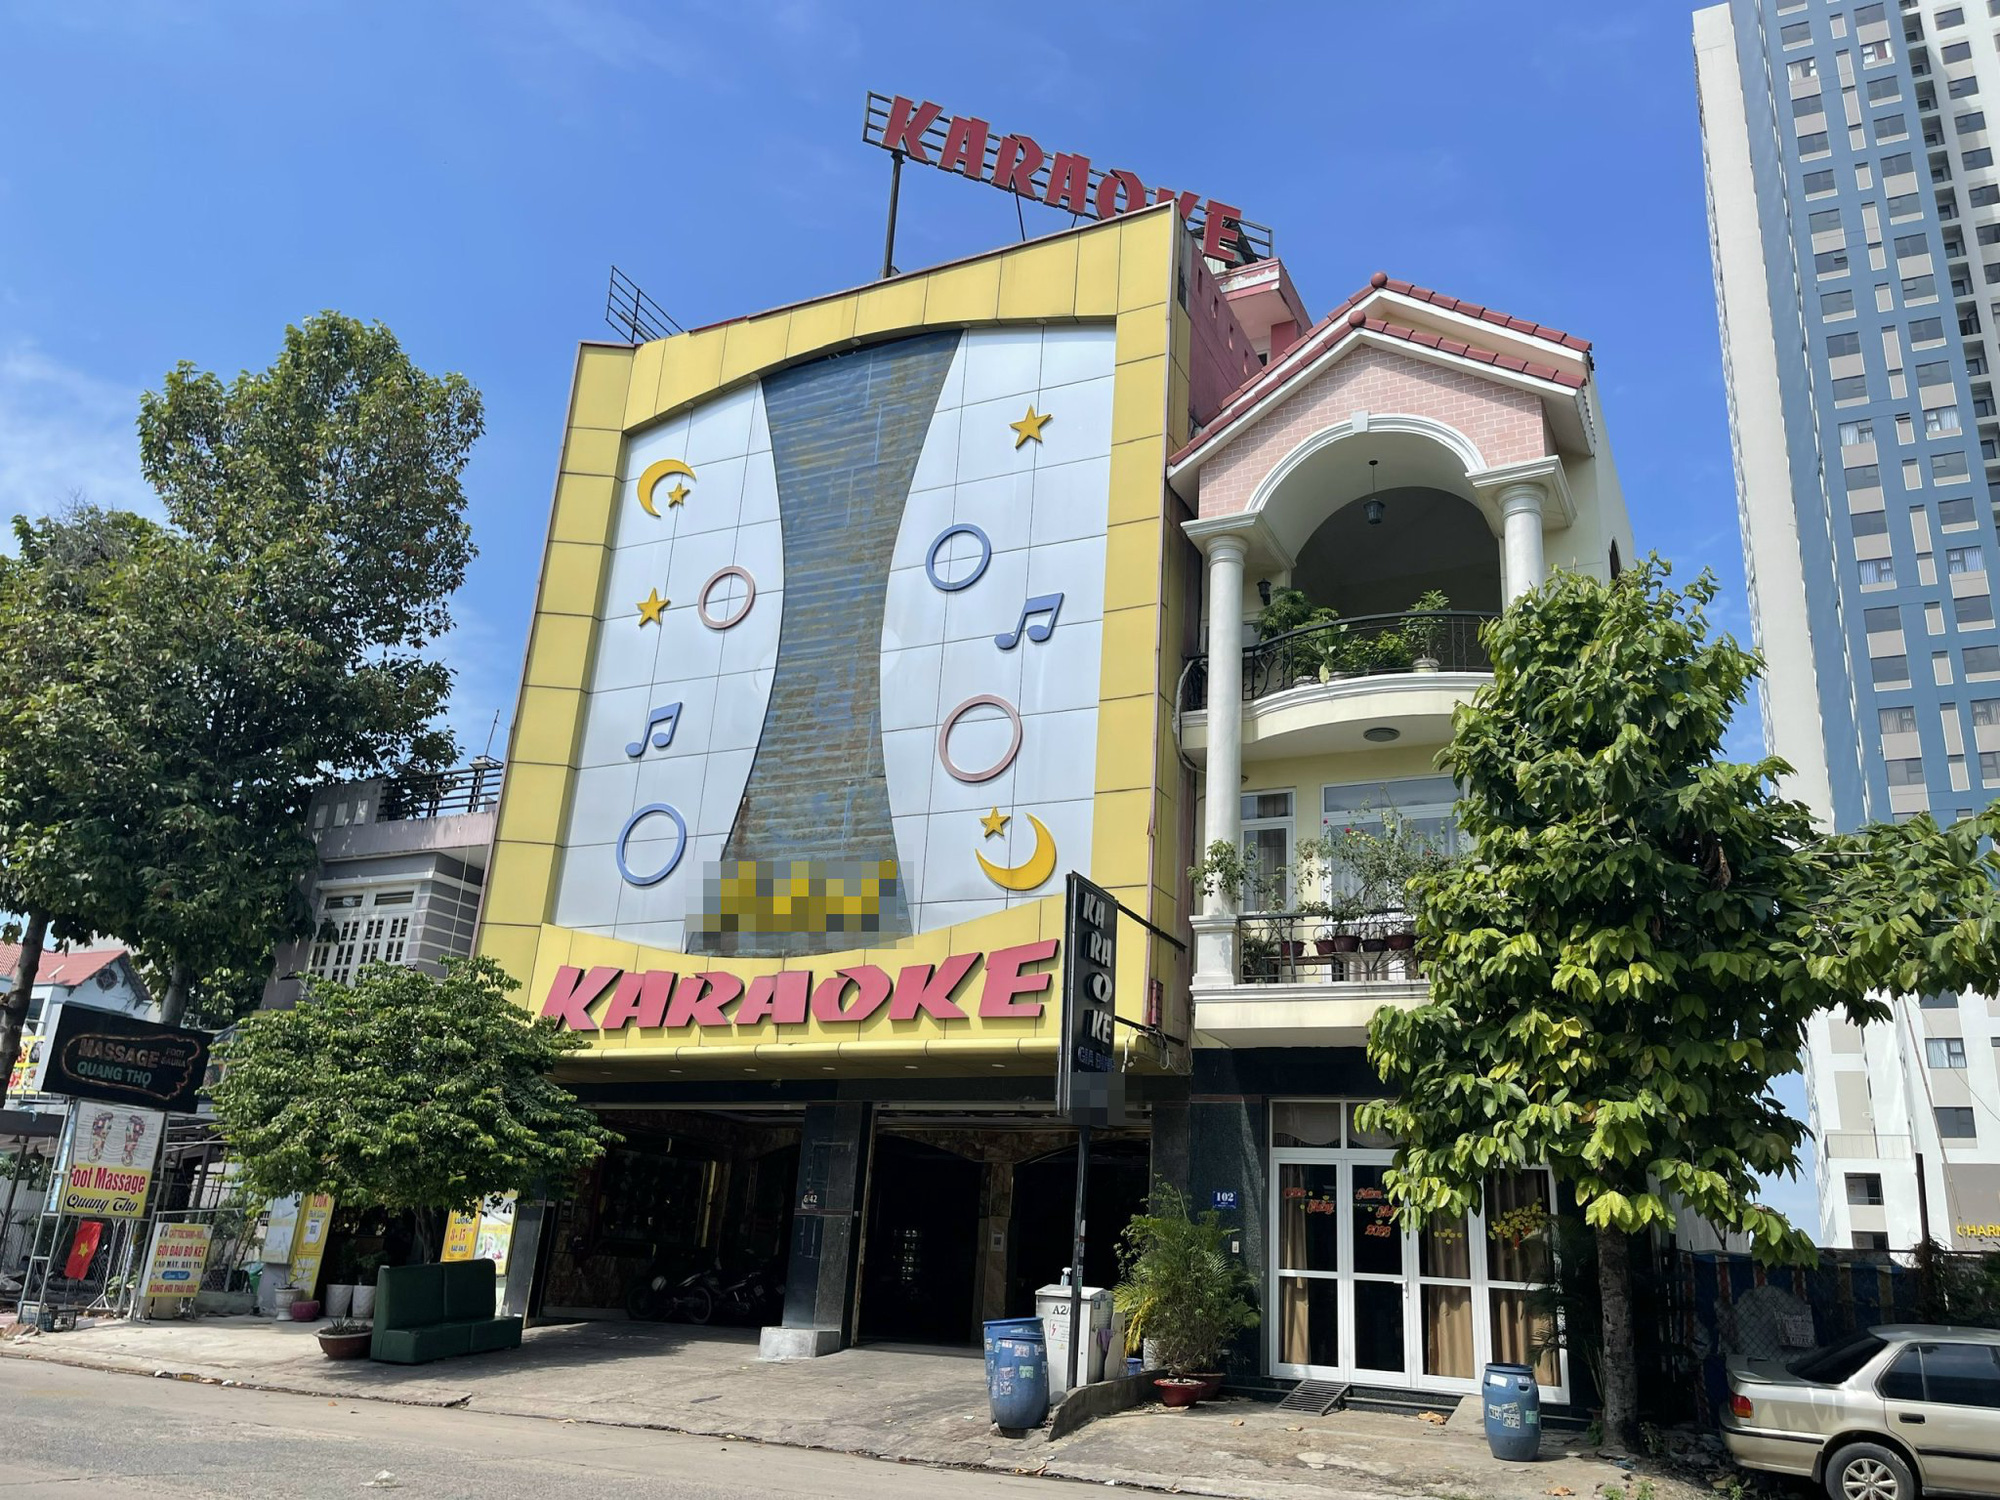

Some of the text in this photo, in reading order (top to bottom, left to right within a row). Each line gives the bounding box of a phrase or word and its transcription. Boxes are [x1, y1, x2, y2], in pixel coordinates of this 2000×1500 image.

[540, 938, 1059, 1031] KARAOKE
[78, 1038, 160, 1068] MASSAGE
[77, 1061, 152, 1088] QUANG THỌ
[94, 1167, 146, 1196] Massage
[67, 1193, 139, 1215] Quang Thọ
[1216, 1192, 1234, 1202] 102
[1956, 1224, 2000, 1237] CHAR
